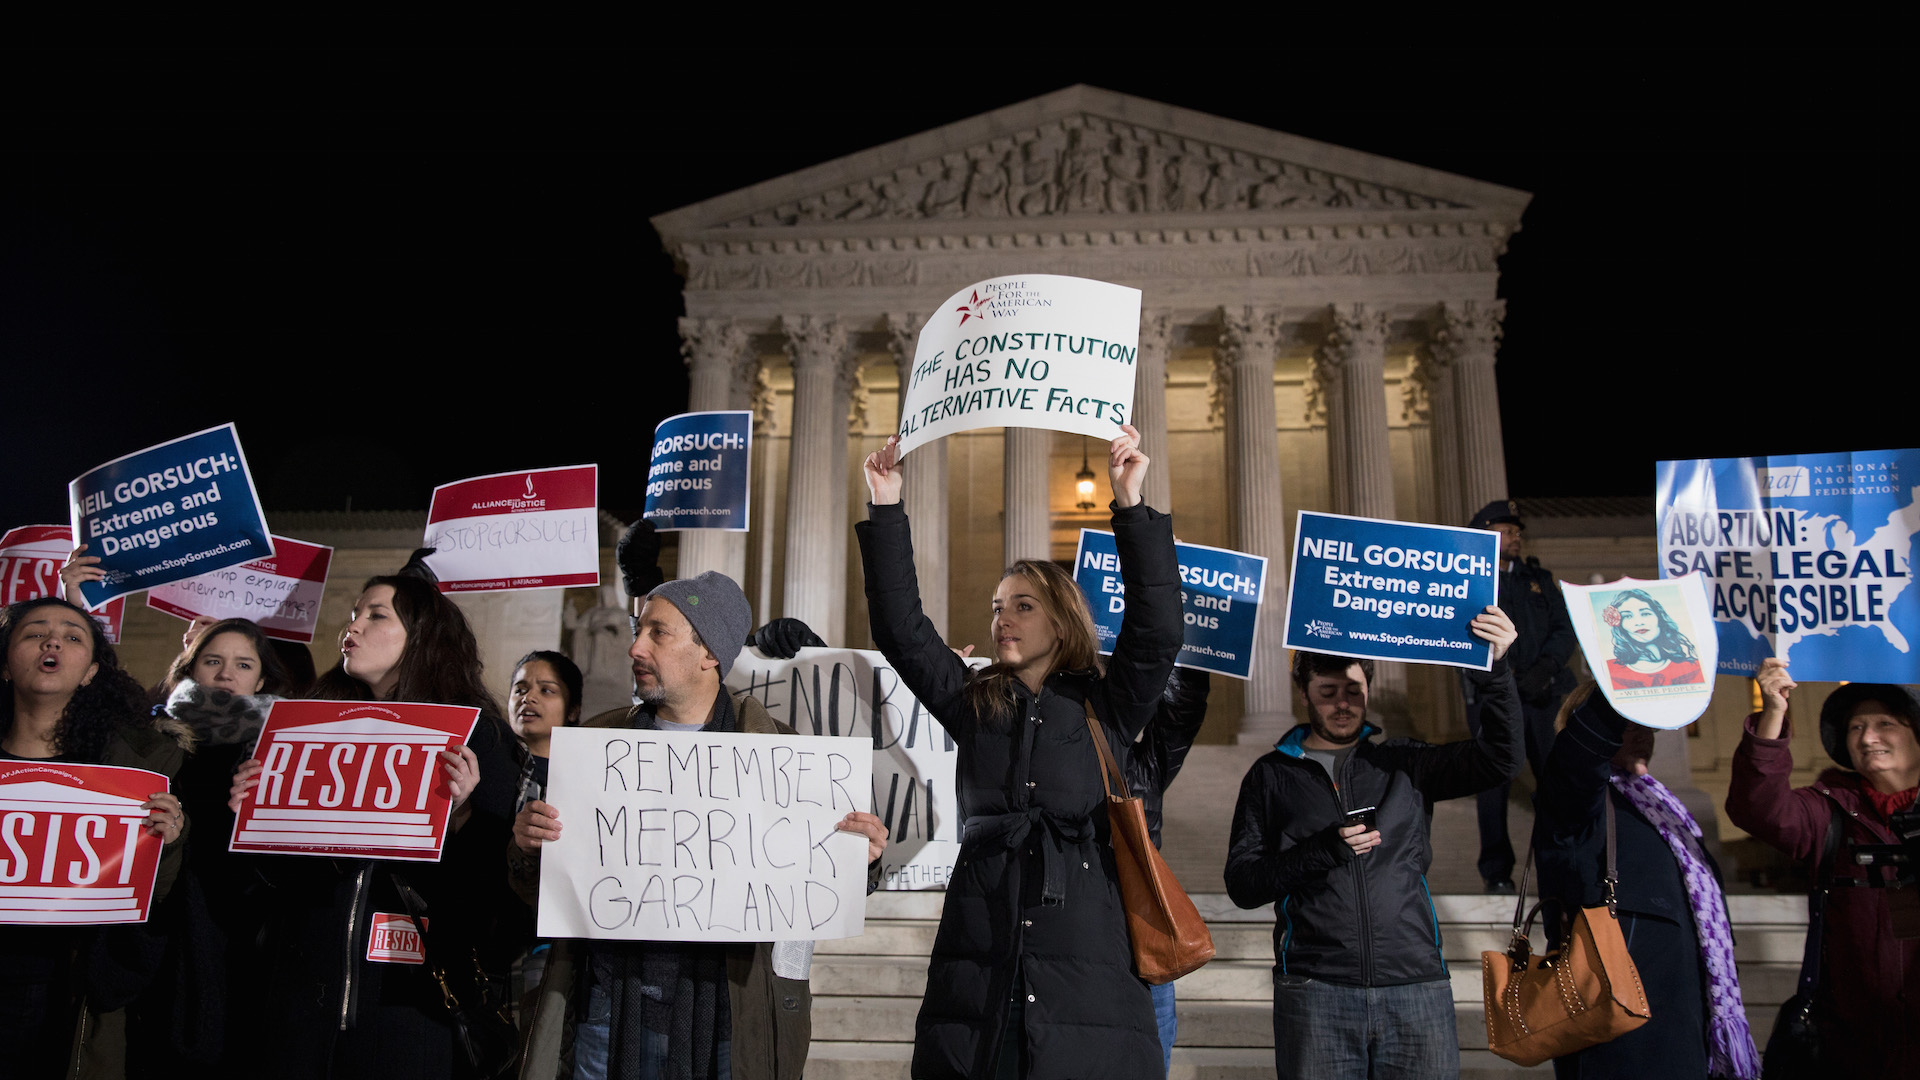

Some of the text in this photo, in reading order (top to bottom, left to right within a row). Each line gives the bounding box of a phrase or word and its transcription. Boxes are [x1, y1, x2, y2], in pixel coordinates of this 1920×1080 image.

[985, 281, 1027, 293] PEOPLE
[998, 290, 1022, 300] FOR
[987, 299, 1052, 310] AMERICAN
[992, 309, 1019, 318] WAY
[913, 332, 1136, 389] THE CONSTITUTION
[944, 358, 1050, 392] HAS NO
[900, 388, 1038, 438] ALTERNATIVE
[654, 433, 744, 458] GORSUCH:
[688, 454, 722, 471] and
[1814, 462, 1899, 474] NATIONAL
[1814, 473, 1900, 485] ABORTION
[75, 452, 239, 519] NEIL GORSUCH:
[1762, 467, 1803, 497] naf
[1815, 485, 1901, 496] FEDERATION
[90, 481, 222, 538] Extreme and
[471, 499, 513, 509] ALLIANCE
[101, 511, 219, 556] Dangerous
[428, 516, 587, 552] #STOPGORSUCH
[1669, 511, 1808, 548] ABORTION:
[135, 538, 252, 577] www.StopGorsuch.com
[1302, 536, 1491, 577] NEIL GORSUCH:
[1668, 549, 1906, 582] SAFE, LEGAL
[1083, 551, 1256, 596] NEI RSUCH:
[1324, 565, 1469, 600] Extreme and
[1193, 595, 1232, 613] and
[1333, 589, 1455, 619] Dangerous
[1713, 583, 1884, 634] ACCESSIBLE
[1348, 630, 1473, 650] www.StopGorsuch.com
[1642, 687, 1660, 695] THE
[1662, 684, 1697, 694] PEOPLE
[338, 705, 402, 720] AFJActionCampaign.org
[871, 666, 955, 752] BA
[1, 766, 85, 785] AFJActionCampaign.org
[255, 742, 447, 811] RESIST
[604, 738, 857, 812] REMEMBER
[0, 812, 144, 885] SIST
[595, 805, 840, 878] MERRICK
[883, 864, 955, 884] GETHER
[589, 874, 840, 933] GARLAND
